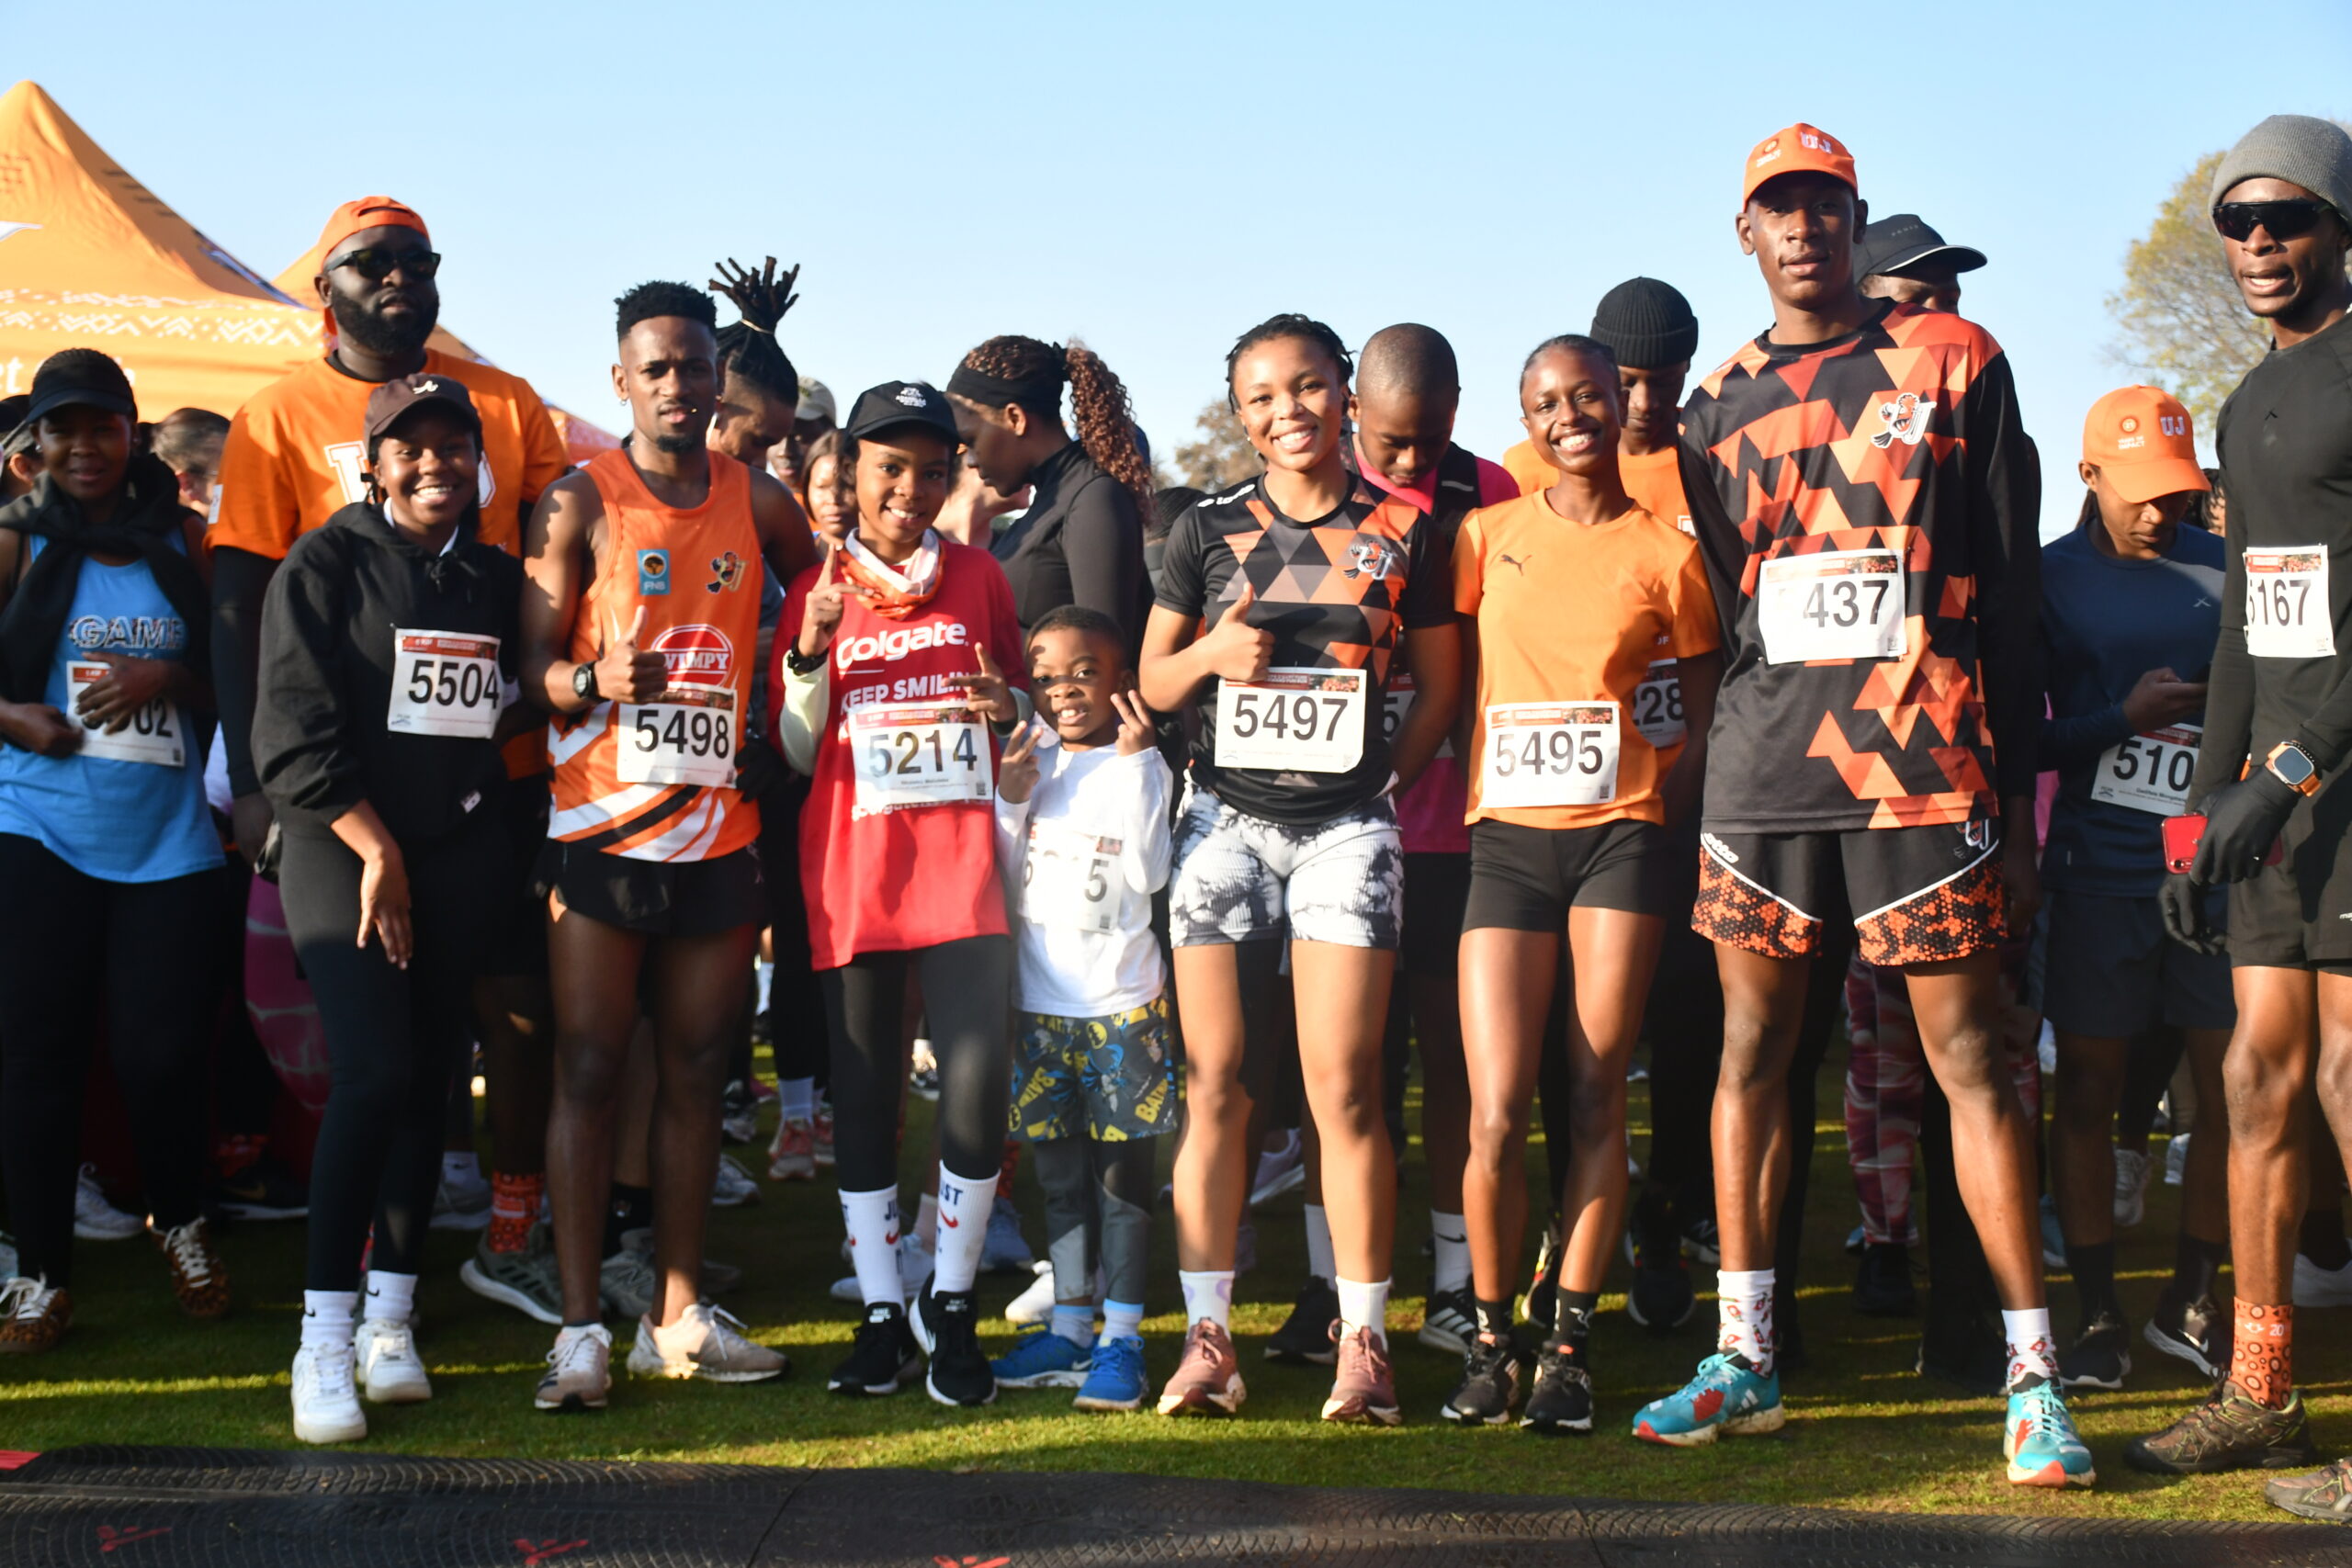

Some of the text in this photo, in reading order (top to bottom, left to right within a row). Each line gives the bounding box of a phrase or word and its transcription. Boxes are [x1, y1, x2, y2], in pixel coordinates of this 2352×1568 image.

[1801, 133, 1832, 153] UJ
[2160, 416, 2185, 436] UJ
[644, 581, 666, 592] FNB
[68, 614, 185, 650] GAME
[836, 621, 967, 670] Colgate
[408, 659, 501, 710] 5504
[840, 683, 889, 716] KEEP
[1633, 682, 1686, 727] 28
[635, 709, 729, 760] 5498
[1233, 694, 1348, 741] 5497
[869, 728, 978, 778] 5214
[1496, 730, 1603, 778] 5495
[2113, 740, 2195, 792] 510
[2269, 1324, 2285, 1337] 20
